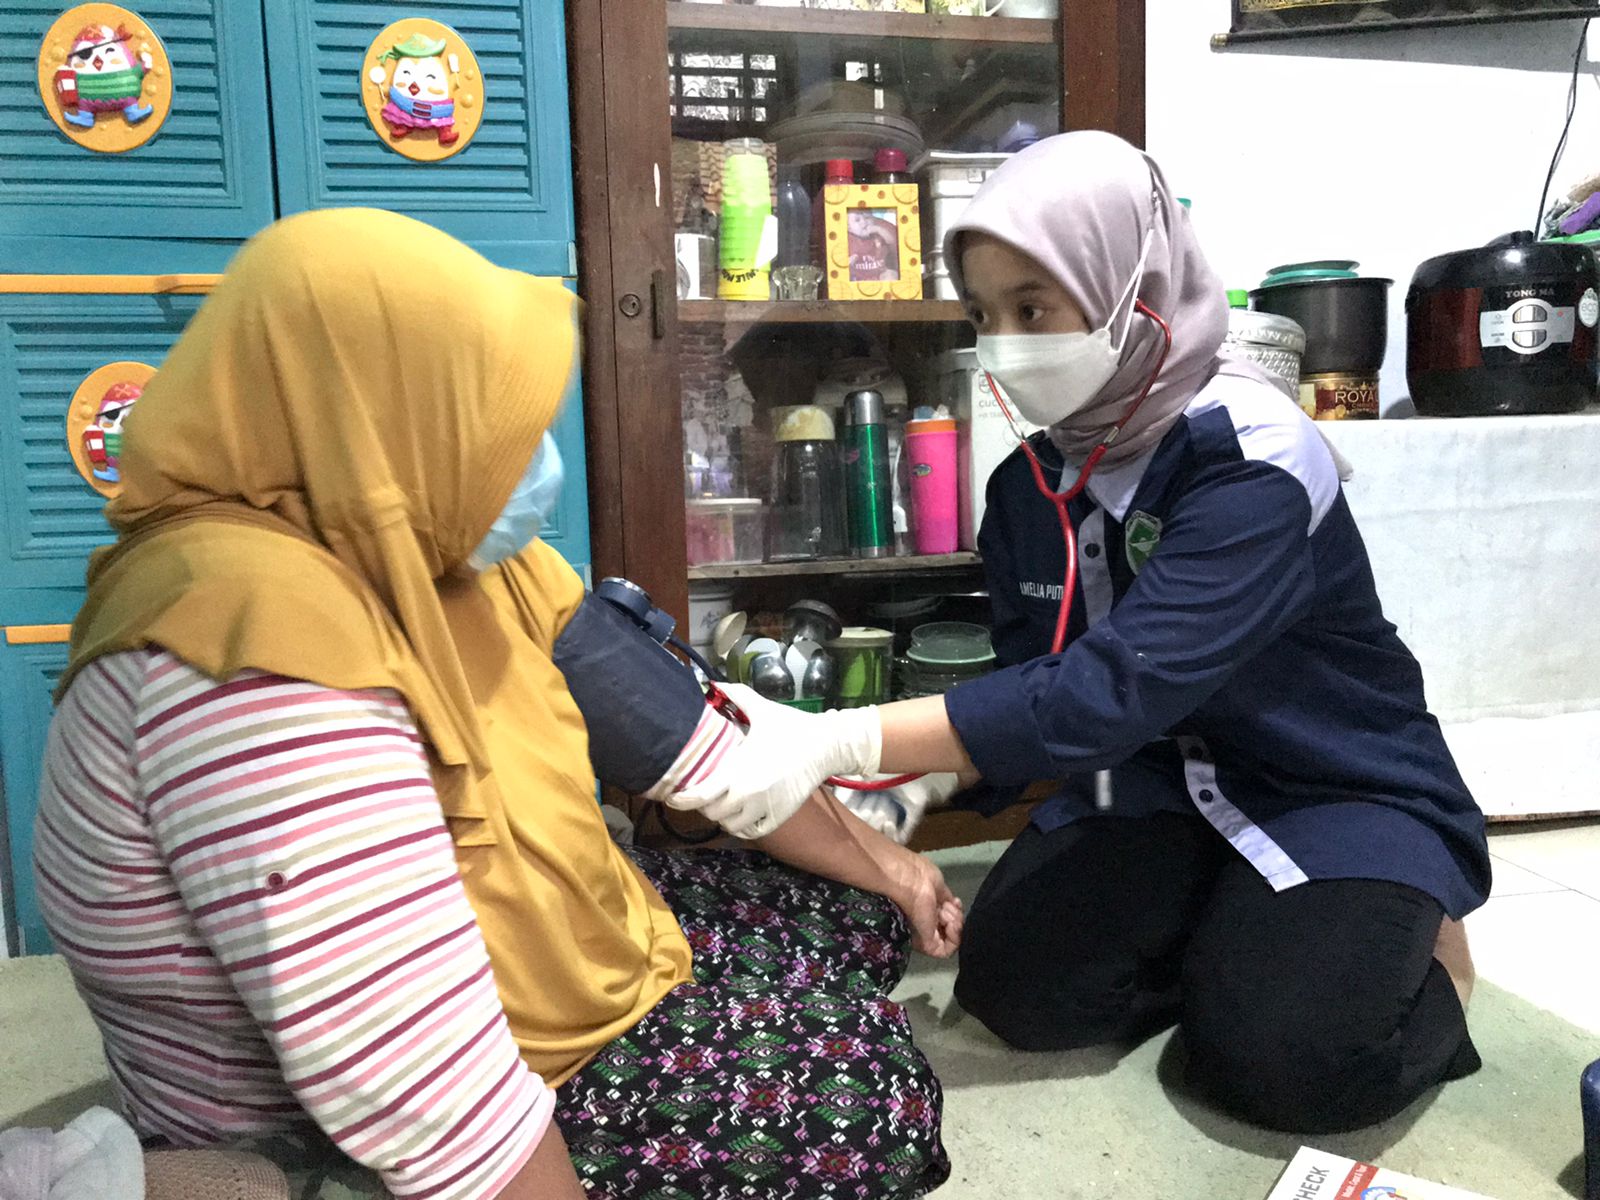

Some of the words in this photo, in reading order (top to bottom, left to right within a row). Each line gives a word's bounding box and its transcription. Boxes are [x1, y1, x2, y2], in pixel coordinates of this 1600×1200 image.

[1506, 289, 1537, 298] YONG
[1539, 288, 1555, 297] MA
[1292, 1166, 1330, 1200] HECK
